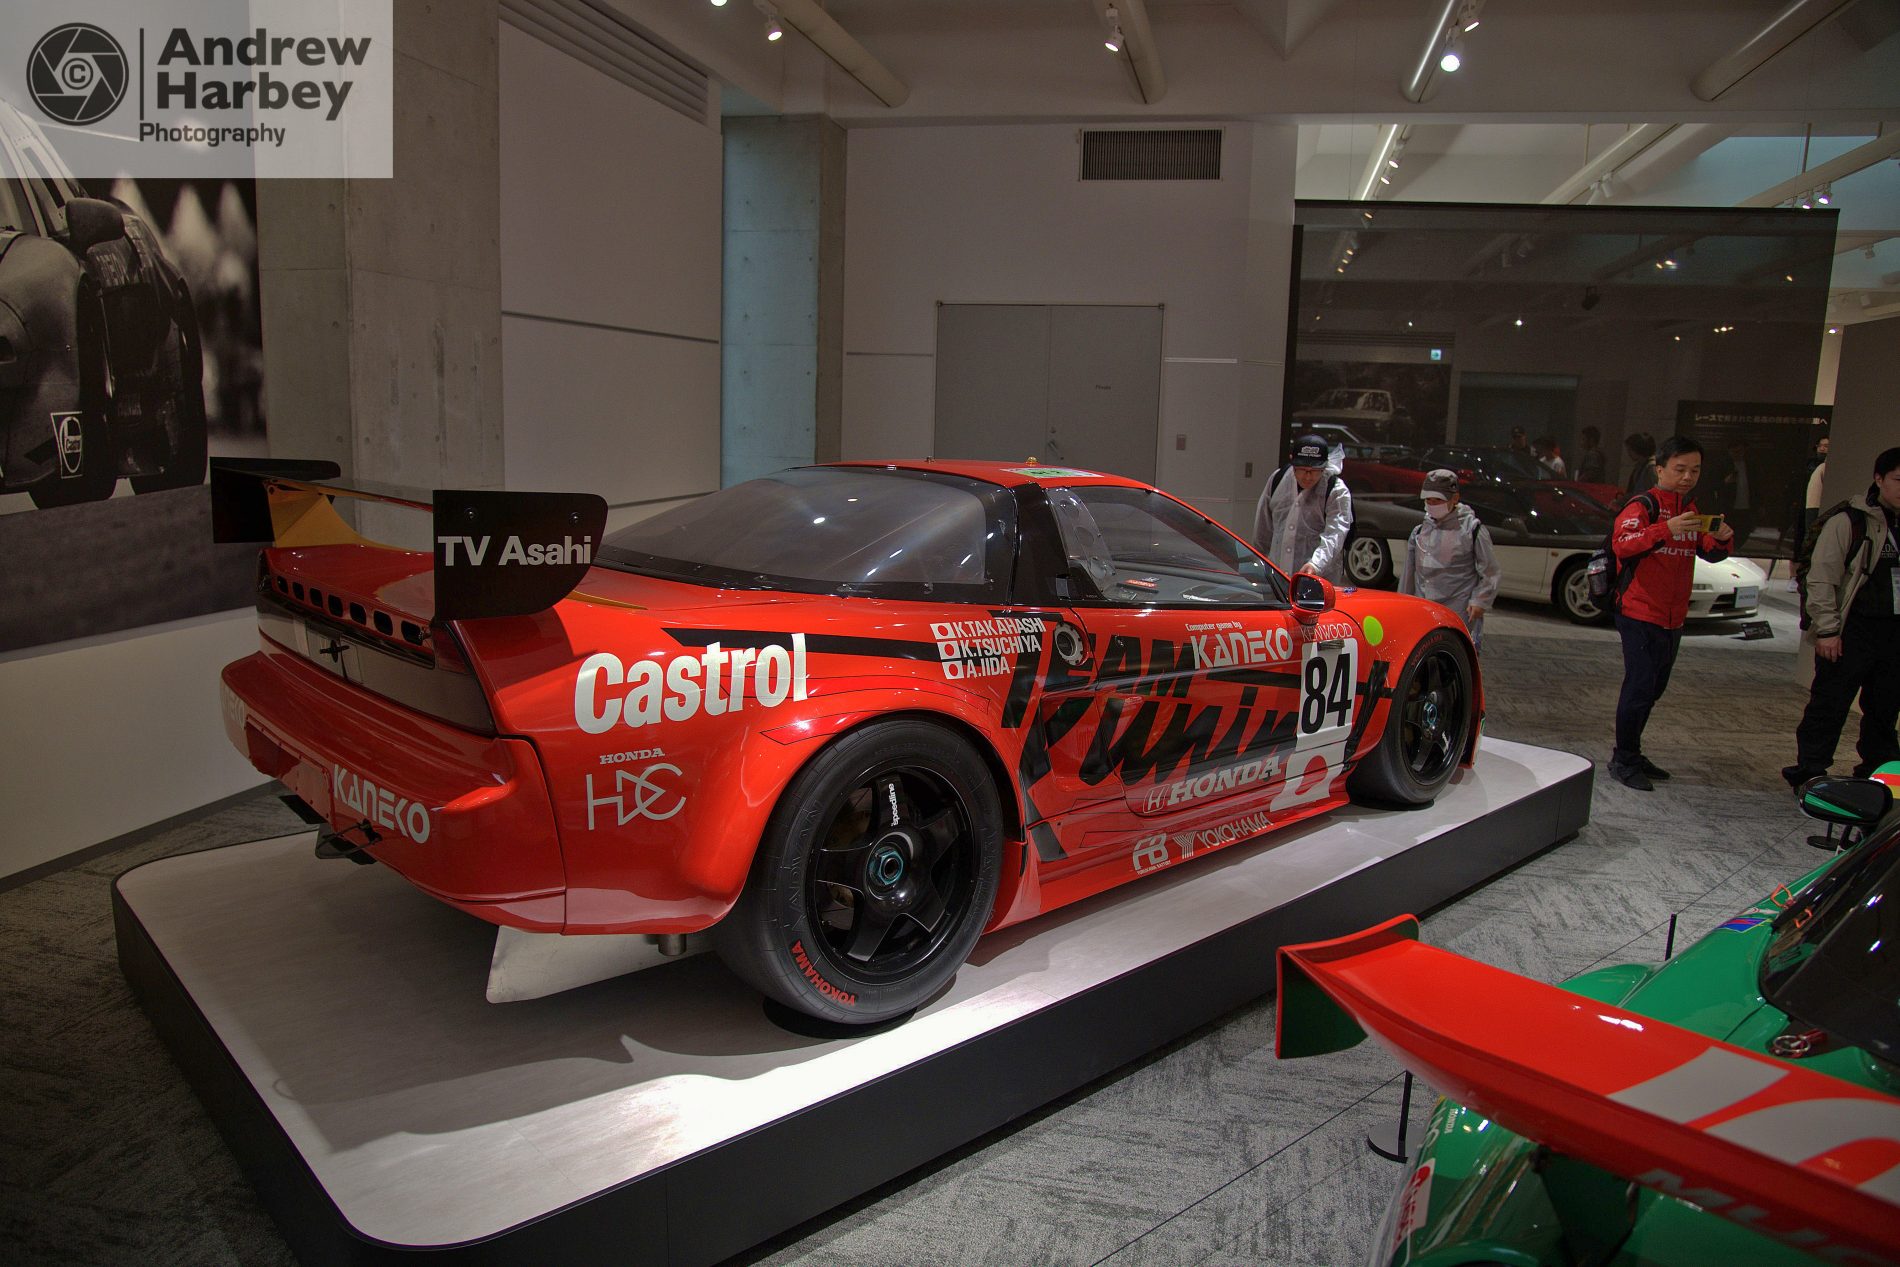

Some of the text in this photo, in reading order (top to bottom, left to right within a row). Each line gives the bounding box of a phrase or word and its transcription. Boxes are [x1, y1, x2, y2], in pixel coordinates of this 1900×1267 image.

[437, 535, 592, 566] TV Asahi
[952, 617, 1047, 639] K.TAKAHASHI
[1185, 620, 1243, 632] Computer game by
[1301, 622, 1353, 642] KENWOOD
[960, 634, 1042, 668] K.TSUCHIYA
[966, 656, 1011, 679] A.IIDA
[1190, 627, 1294, 670] KANEKO
[574, 632, 808, 734] Castrol
[1301, 653, 1353, 734] 84
[600, 747, 666, 765] HONDA
[1167, 755, 1282, 806] HONDA
[333, 764, 430, 844] KANEKO
[888, 783, 900, 827] speedline
[1198, 811, 1274, 849] YOKOHAMA
[791, 940, 856, 1007] YOKOHAMA
